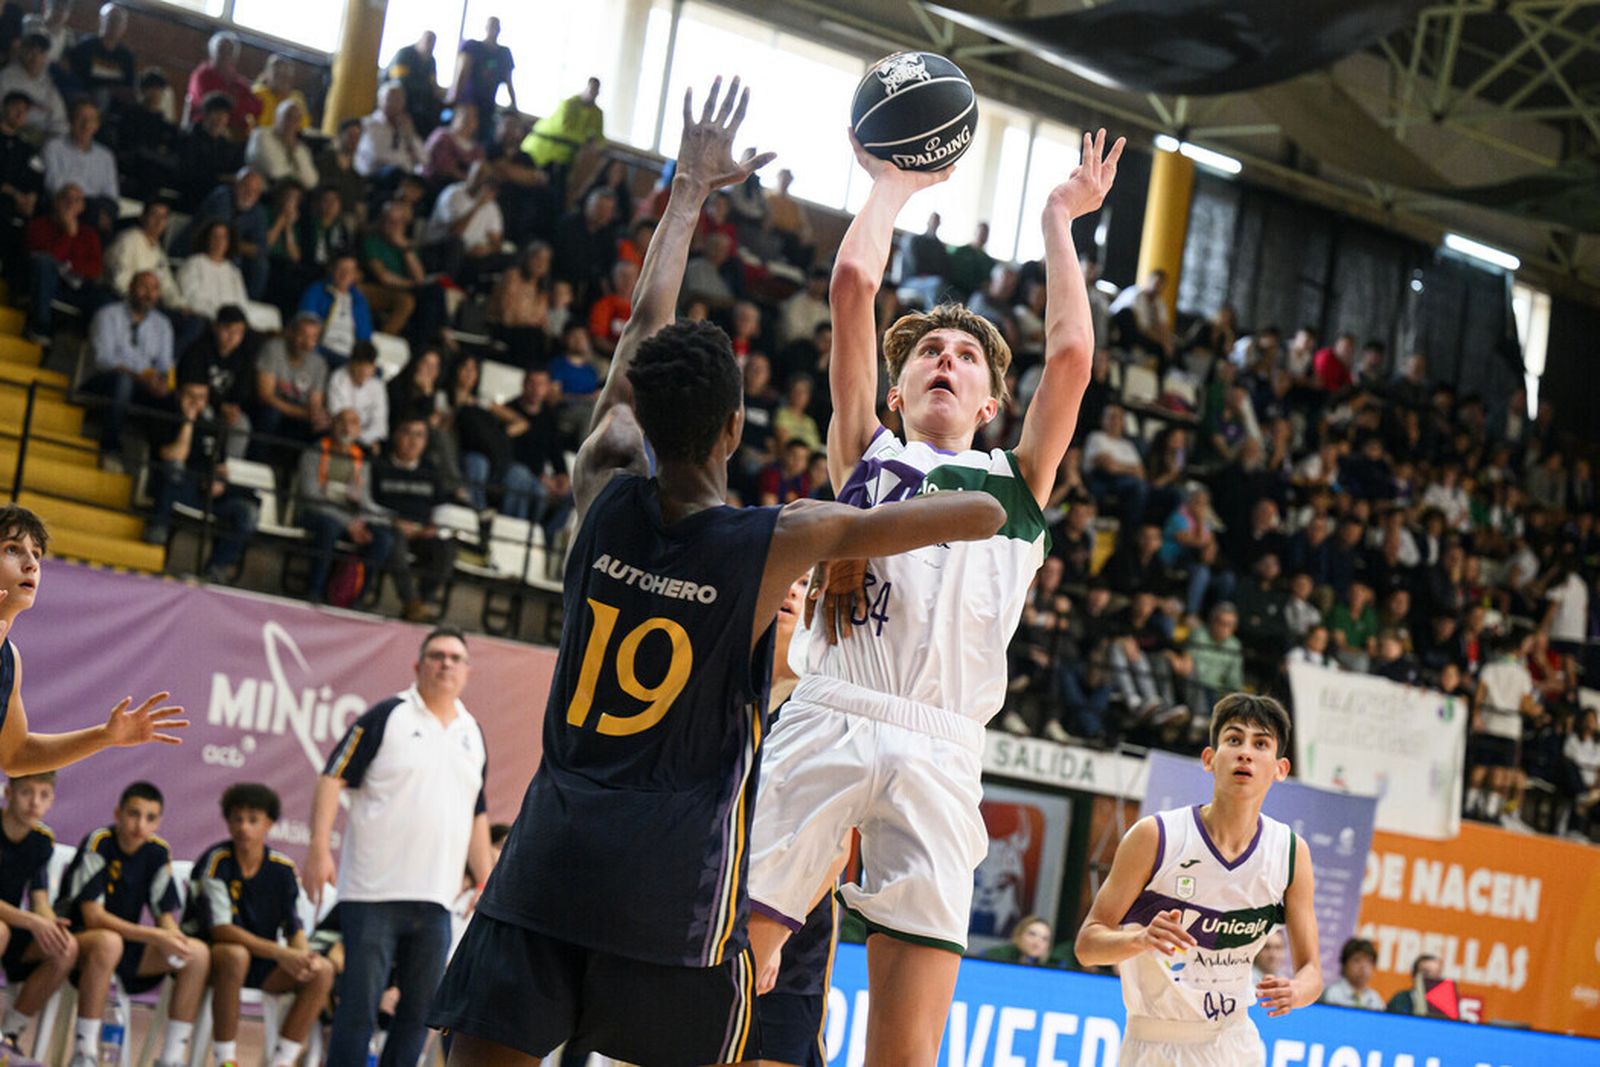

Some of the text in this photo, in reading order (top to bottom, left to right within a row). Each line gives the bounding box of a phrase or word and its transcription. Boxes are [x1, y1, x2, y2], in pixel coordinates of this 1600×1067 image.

[892, 125, 971, 168] SPALDING
[592, 554, 718, 604] AUTOHERO
[566, 597, 694, 736] 19
[994, 740, 1096, 784] SALIDA
[1410, 857, 1542, 922] NACEN
